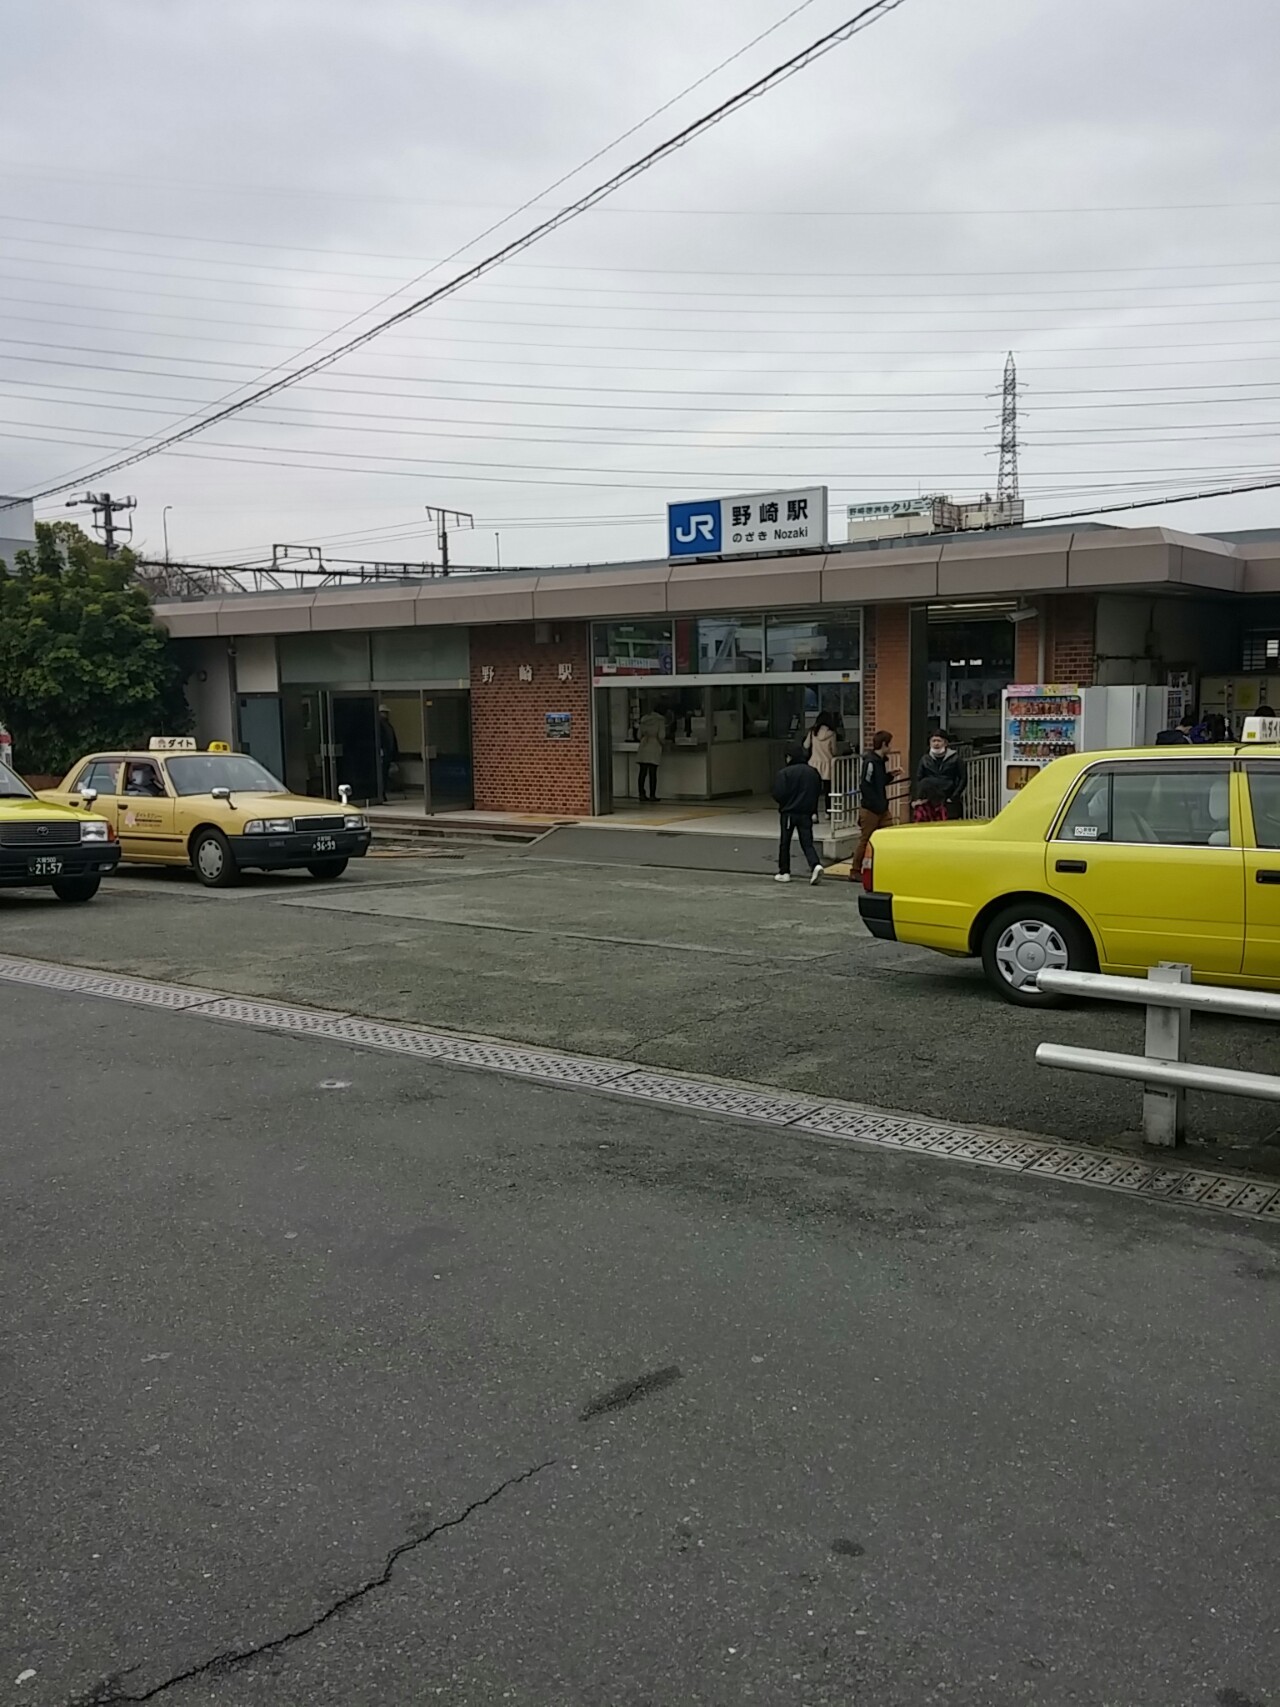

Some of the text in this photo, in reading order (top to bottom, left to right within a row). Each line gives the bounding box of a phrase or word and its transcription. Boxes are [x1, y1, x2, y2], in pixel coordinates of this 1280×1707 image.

[732, 498, 808, 526] 野崎駅
[675, 514, 714, 543] JR
[732, 526, 808, 543] のざき Nozaki
[481, 663, 573, 683] 野崎駅
[168, 738, 193, 748] ダイト
